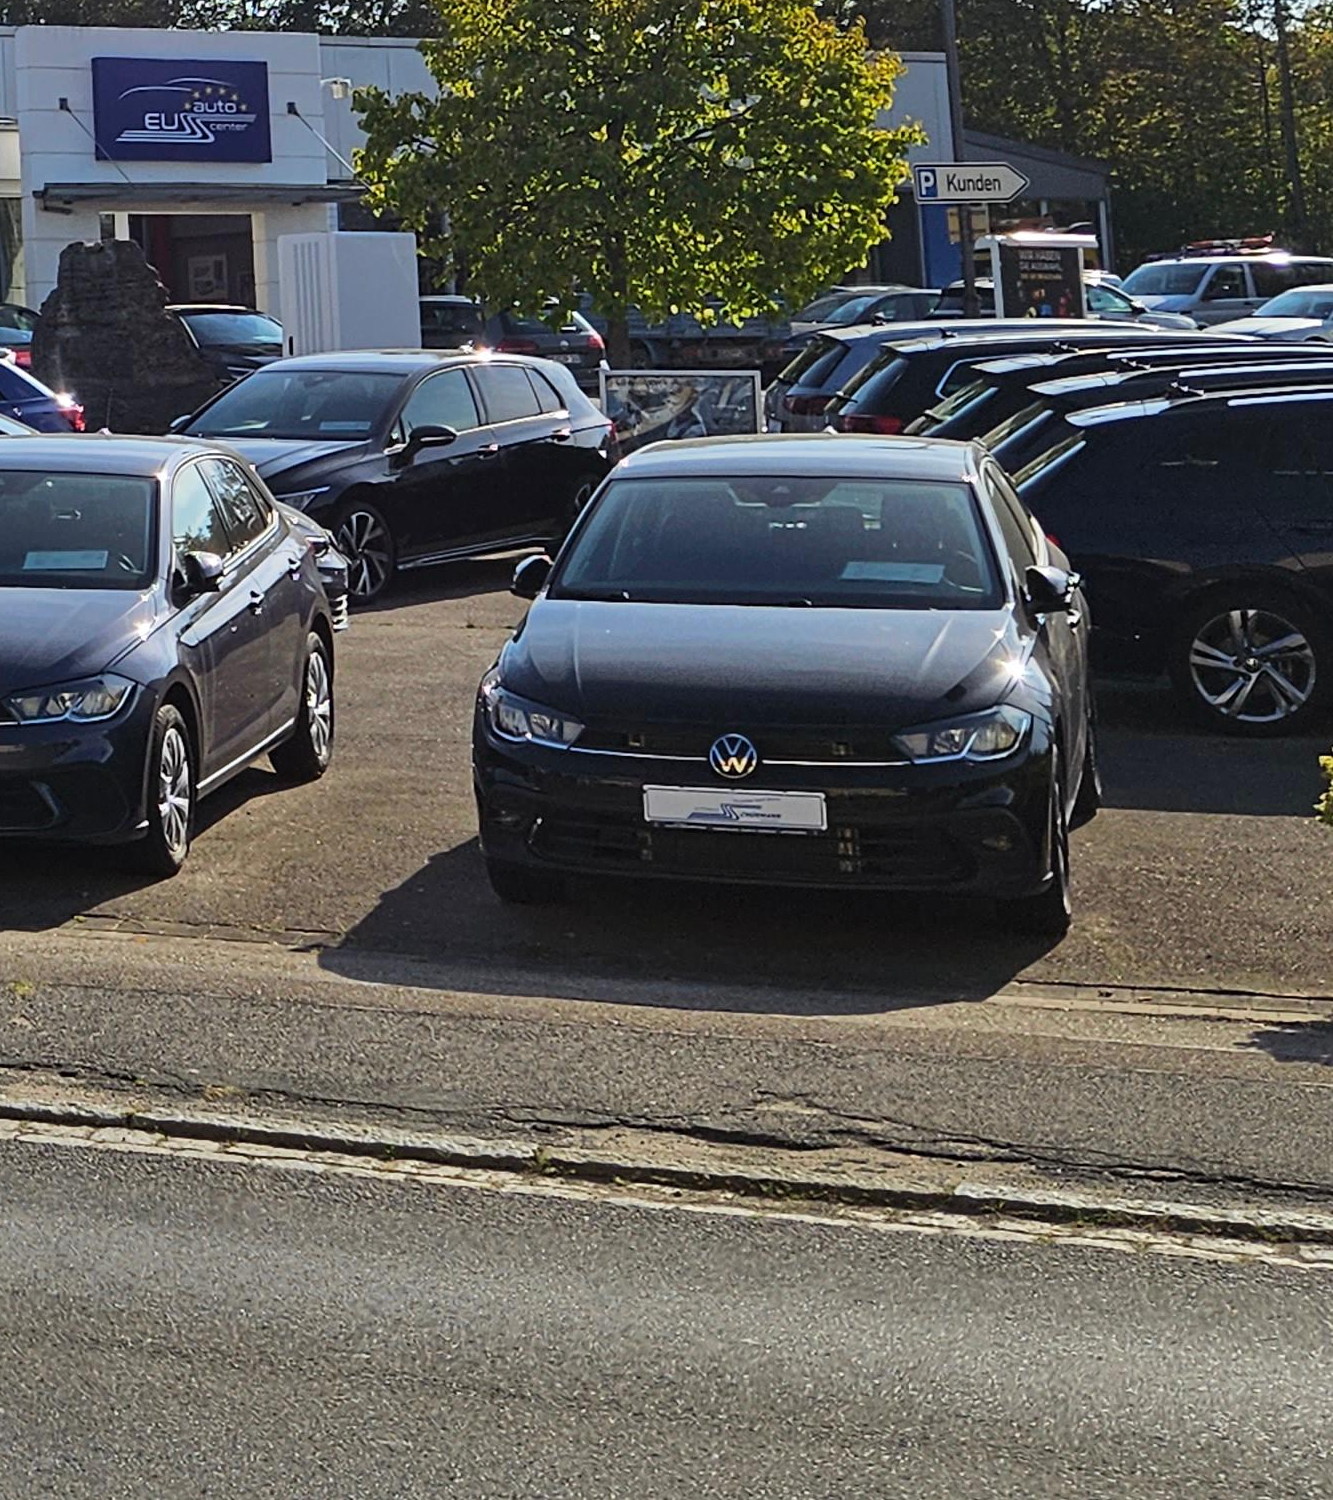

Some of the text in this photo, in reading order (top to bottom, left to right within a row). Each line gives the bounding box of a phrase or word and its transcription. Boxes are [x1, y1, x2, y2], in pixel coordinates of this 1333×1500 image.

[193, 100, 237, 113] auto
[209, 122, 248, 131] center
[919, 171, 1002, 196] P Kunden
